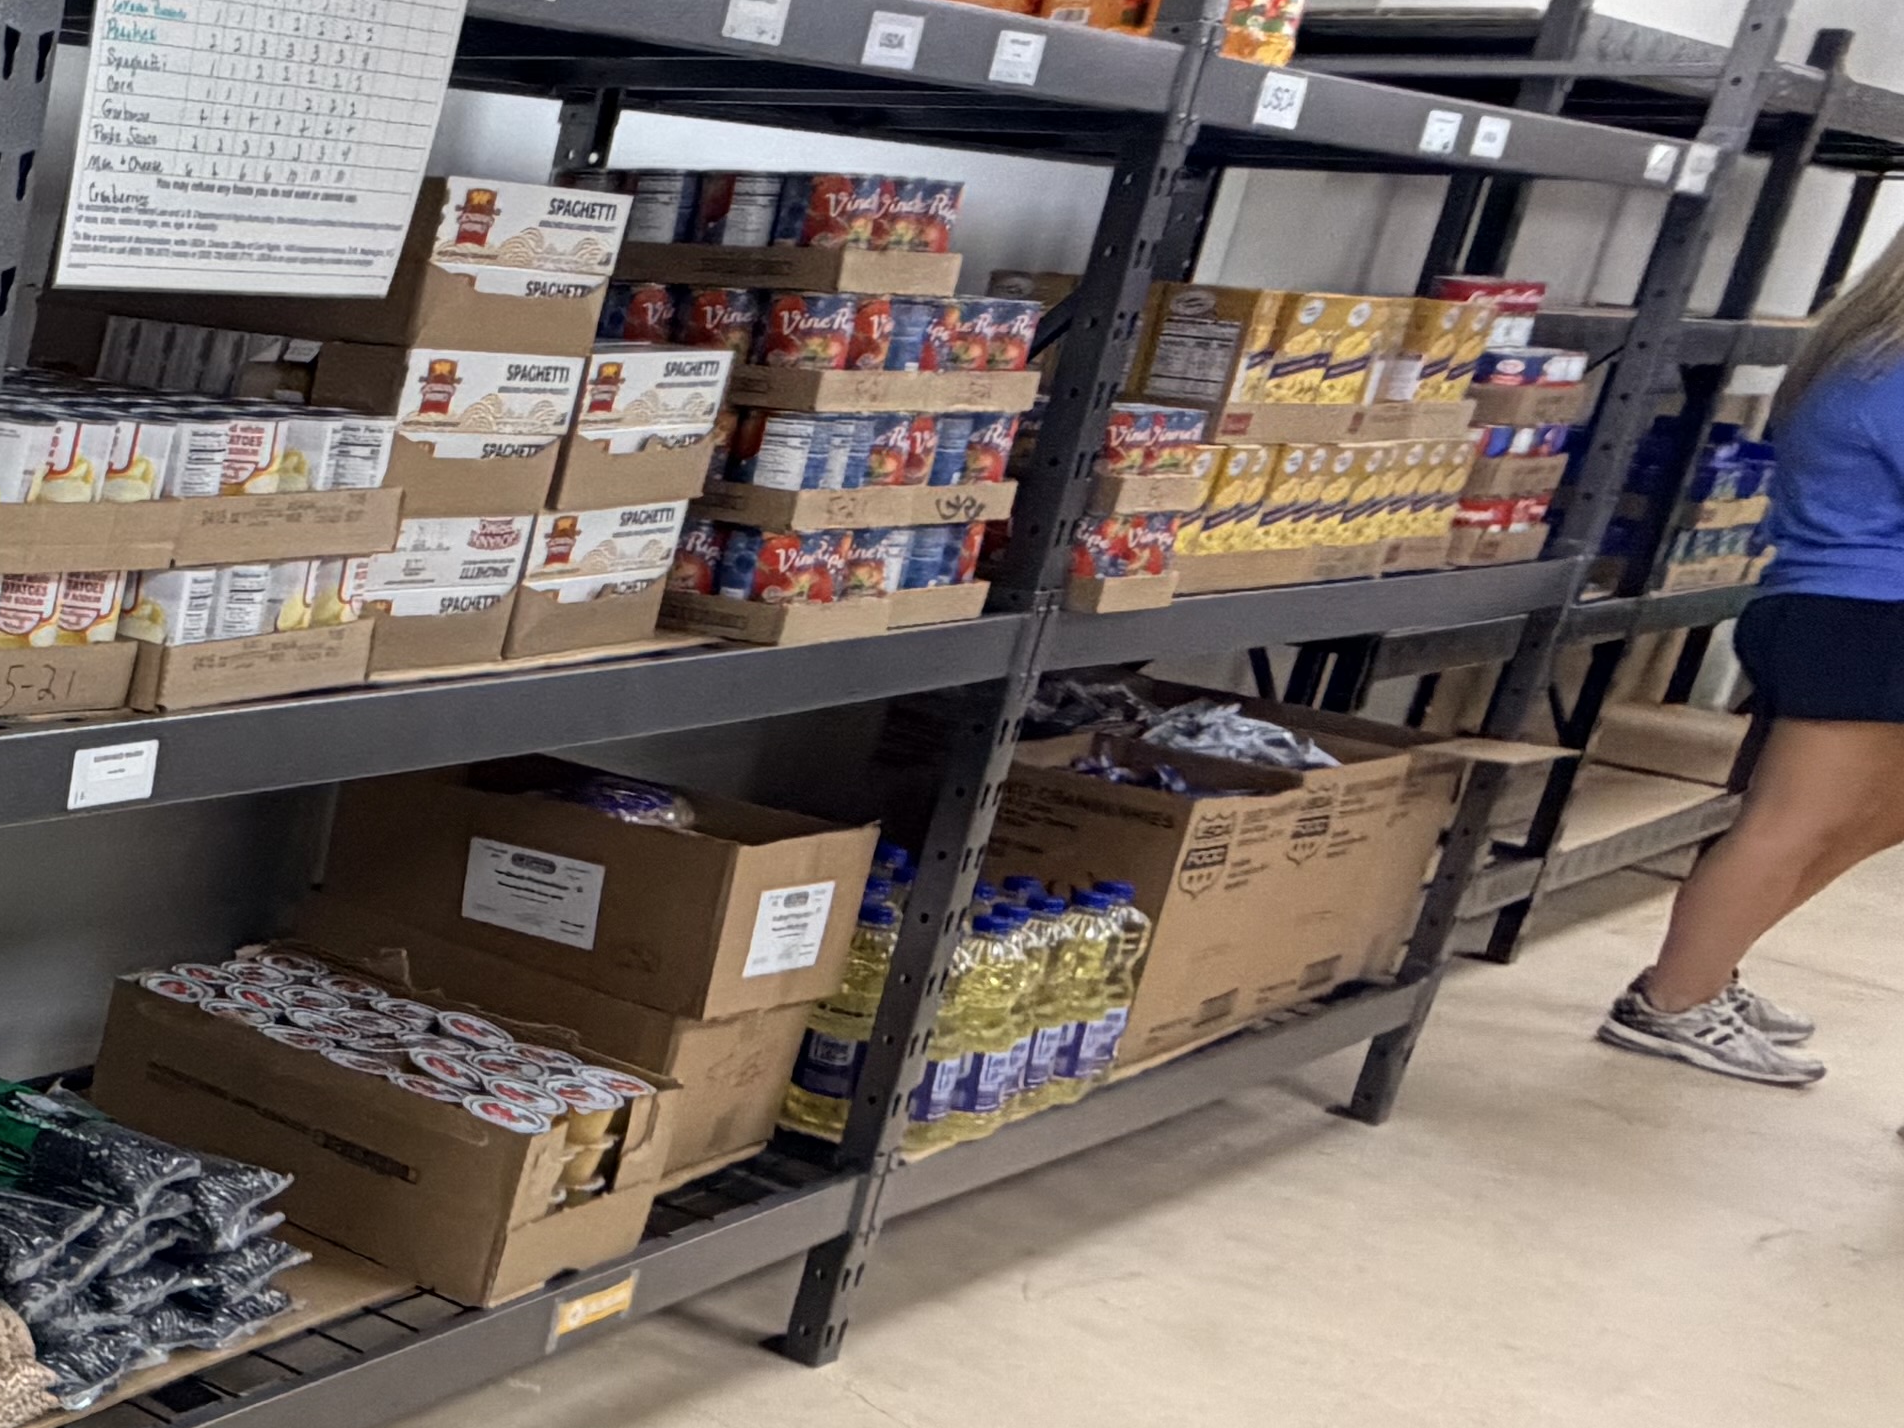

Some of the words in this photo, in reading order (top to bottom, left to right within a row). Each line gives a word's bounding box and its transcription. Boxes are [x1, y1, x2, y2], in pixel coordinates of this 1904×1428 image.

[547, 197, 618, 221] SPAGHETTI
[505, 363, 570, 383] SPAGHETTI
[663, 360, 720, 379] SPAGHETTI
[619, 506, 675, 528] SPAGHETTI
